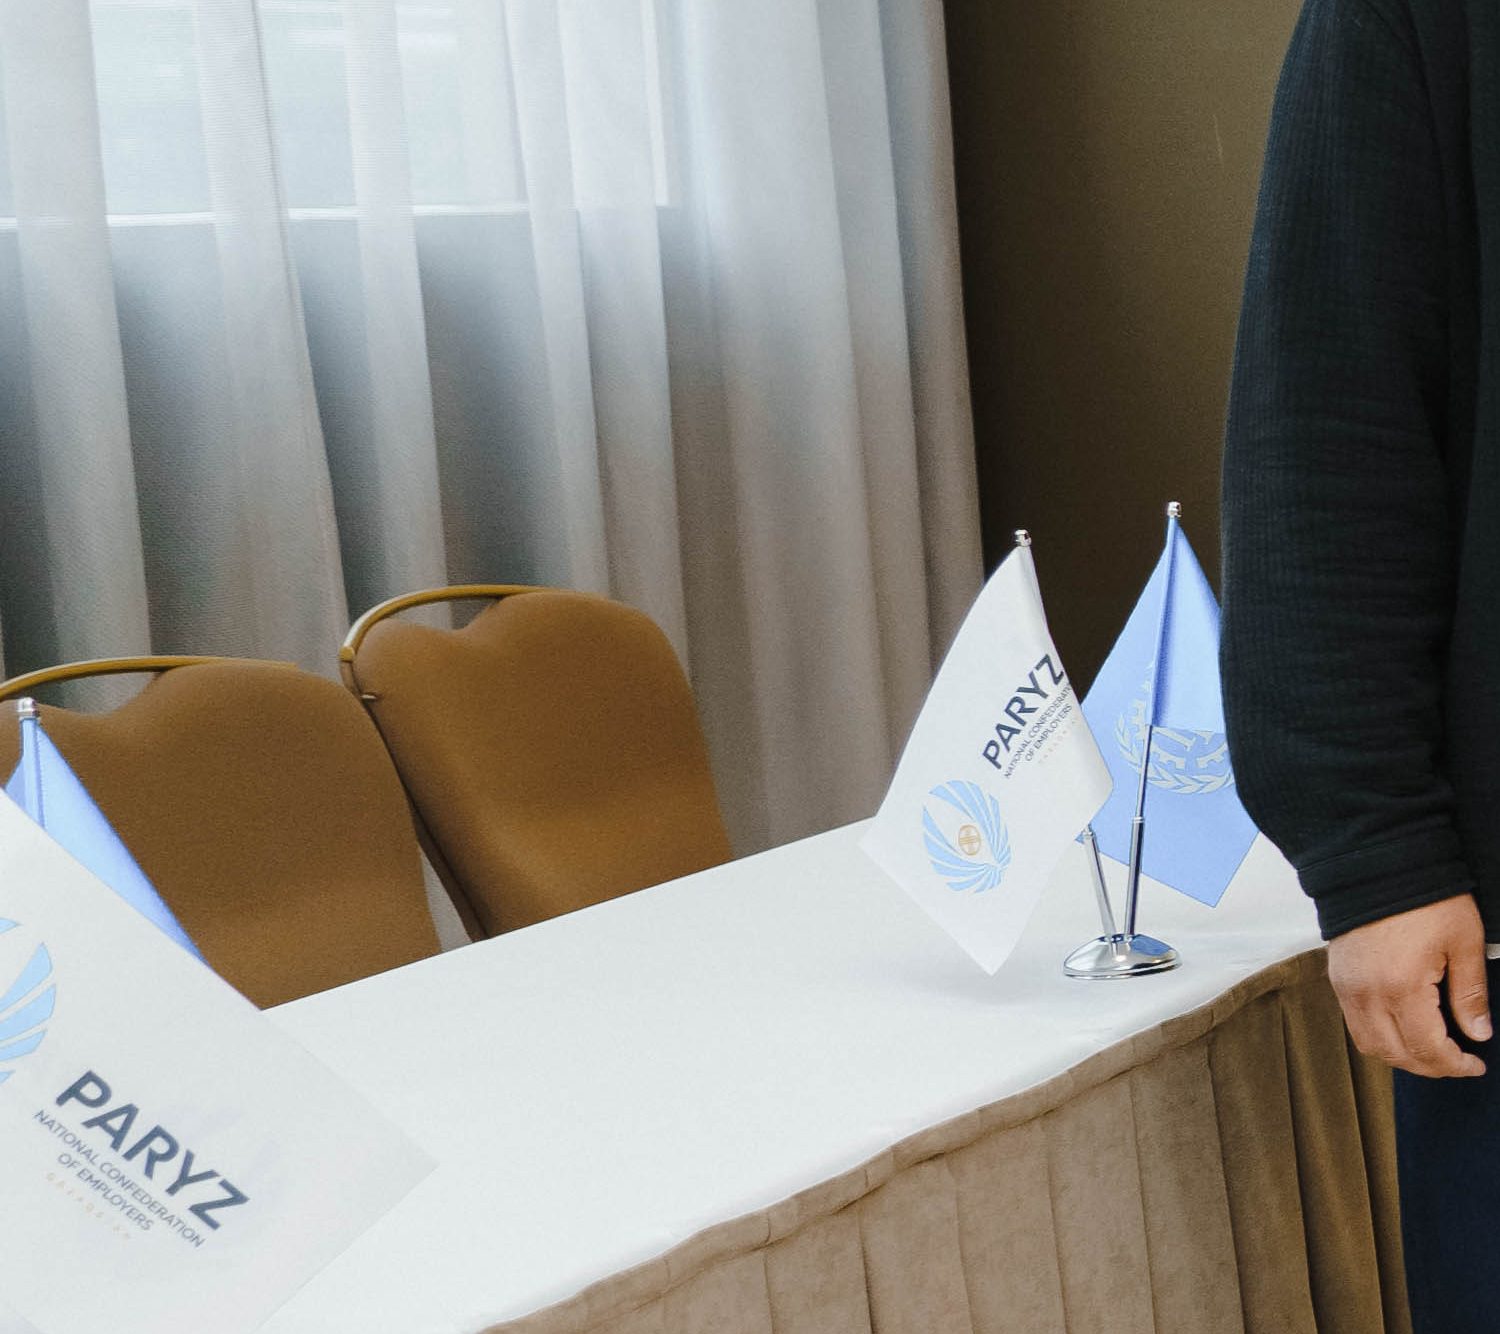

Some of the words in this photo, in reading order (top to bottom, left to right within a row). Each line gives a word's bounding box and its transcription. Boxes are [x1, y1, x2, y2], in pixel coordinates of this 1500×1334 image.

[983, 654, 1064, 770] PARYZ
[33, 1109, 101, 1167] NATIONAL
[99, 1161, 206, 1248] CONFEDERATION
[55, 1070, 250, 1231] PARYZ
[57, 1153, 82, 1171] OF
[76, 1168, 155, 1231] EMPLOYERS
